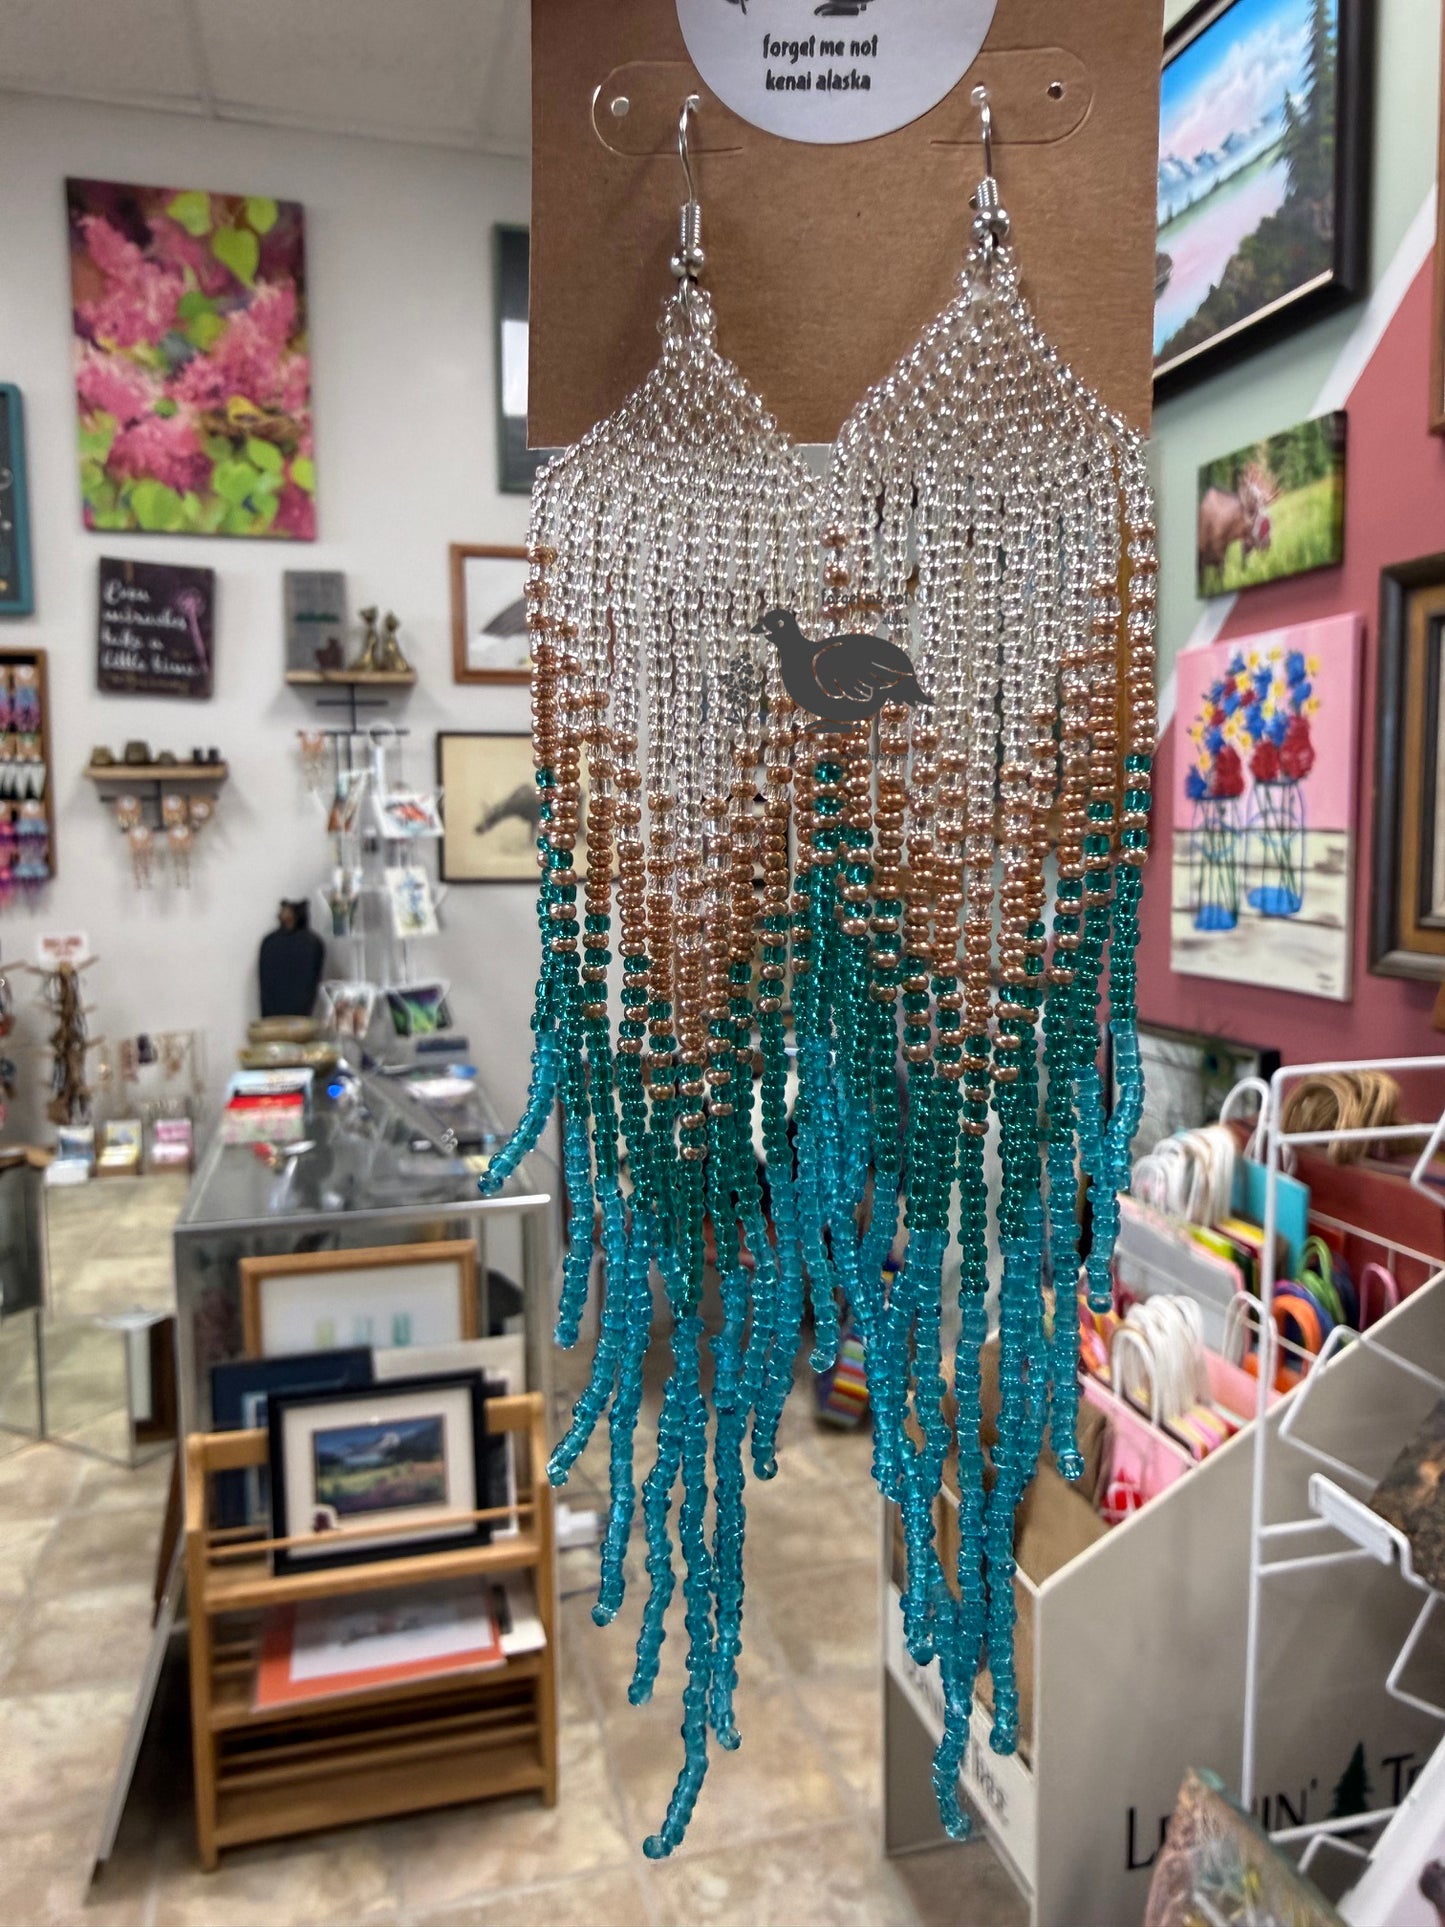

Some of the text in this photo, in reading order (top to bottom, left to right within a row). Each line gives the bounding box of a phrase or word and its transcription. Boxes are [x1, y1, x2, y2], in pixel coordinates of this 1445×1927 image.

[763, 33, 878, 64] forget me not
[765, 68, 871, 93] kenai alaska
